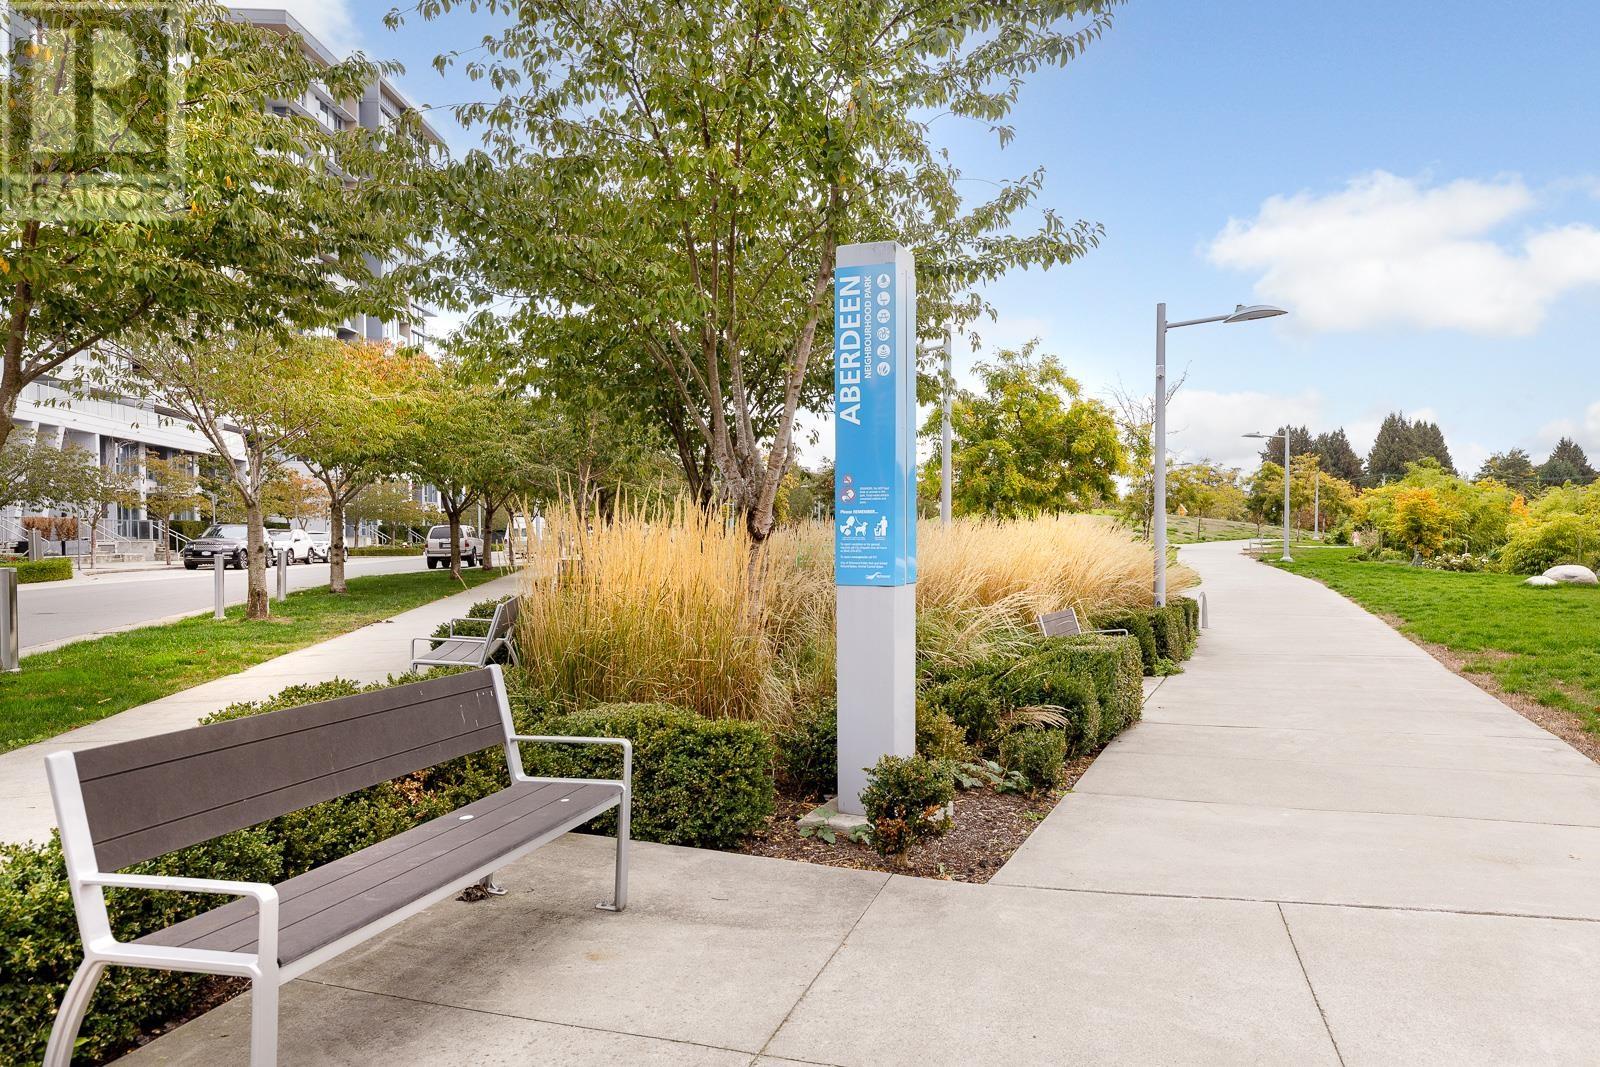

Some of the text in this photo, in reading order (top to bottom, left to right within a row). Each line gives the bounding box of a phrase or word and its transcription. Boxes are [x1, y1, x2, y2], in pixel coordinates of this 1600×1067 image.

[839, 276, 861, 426] ABERDEEN
[864, 275, 872, 379] NEIGHBOURHOOD PARK
